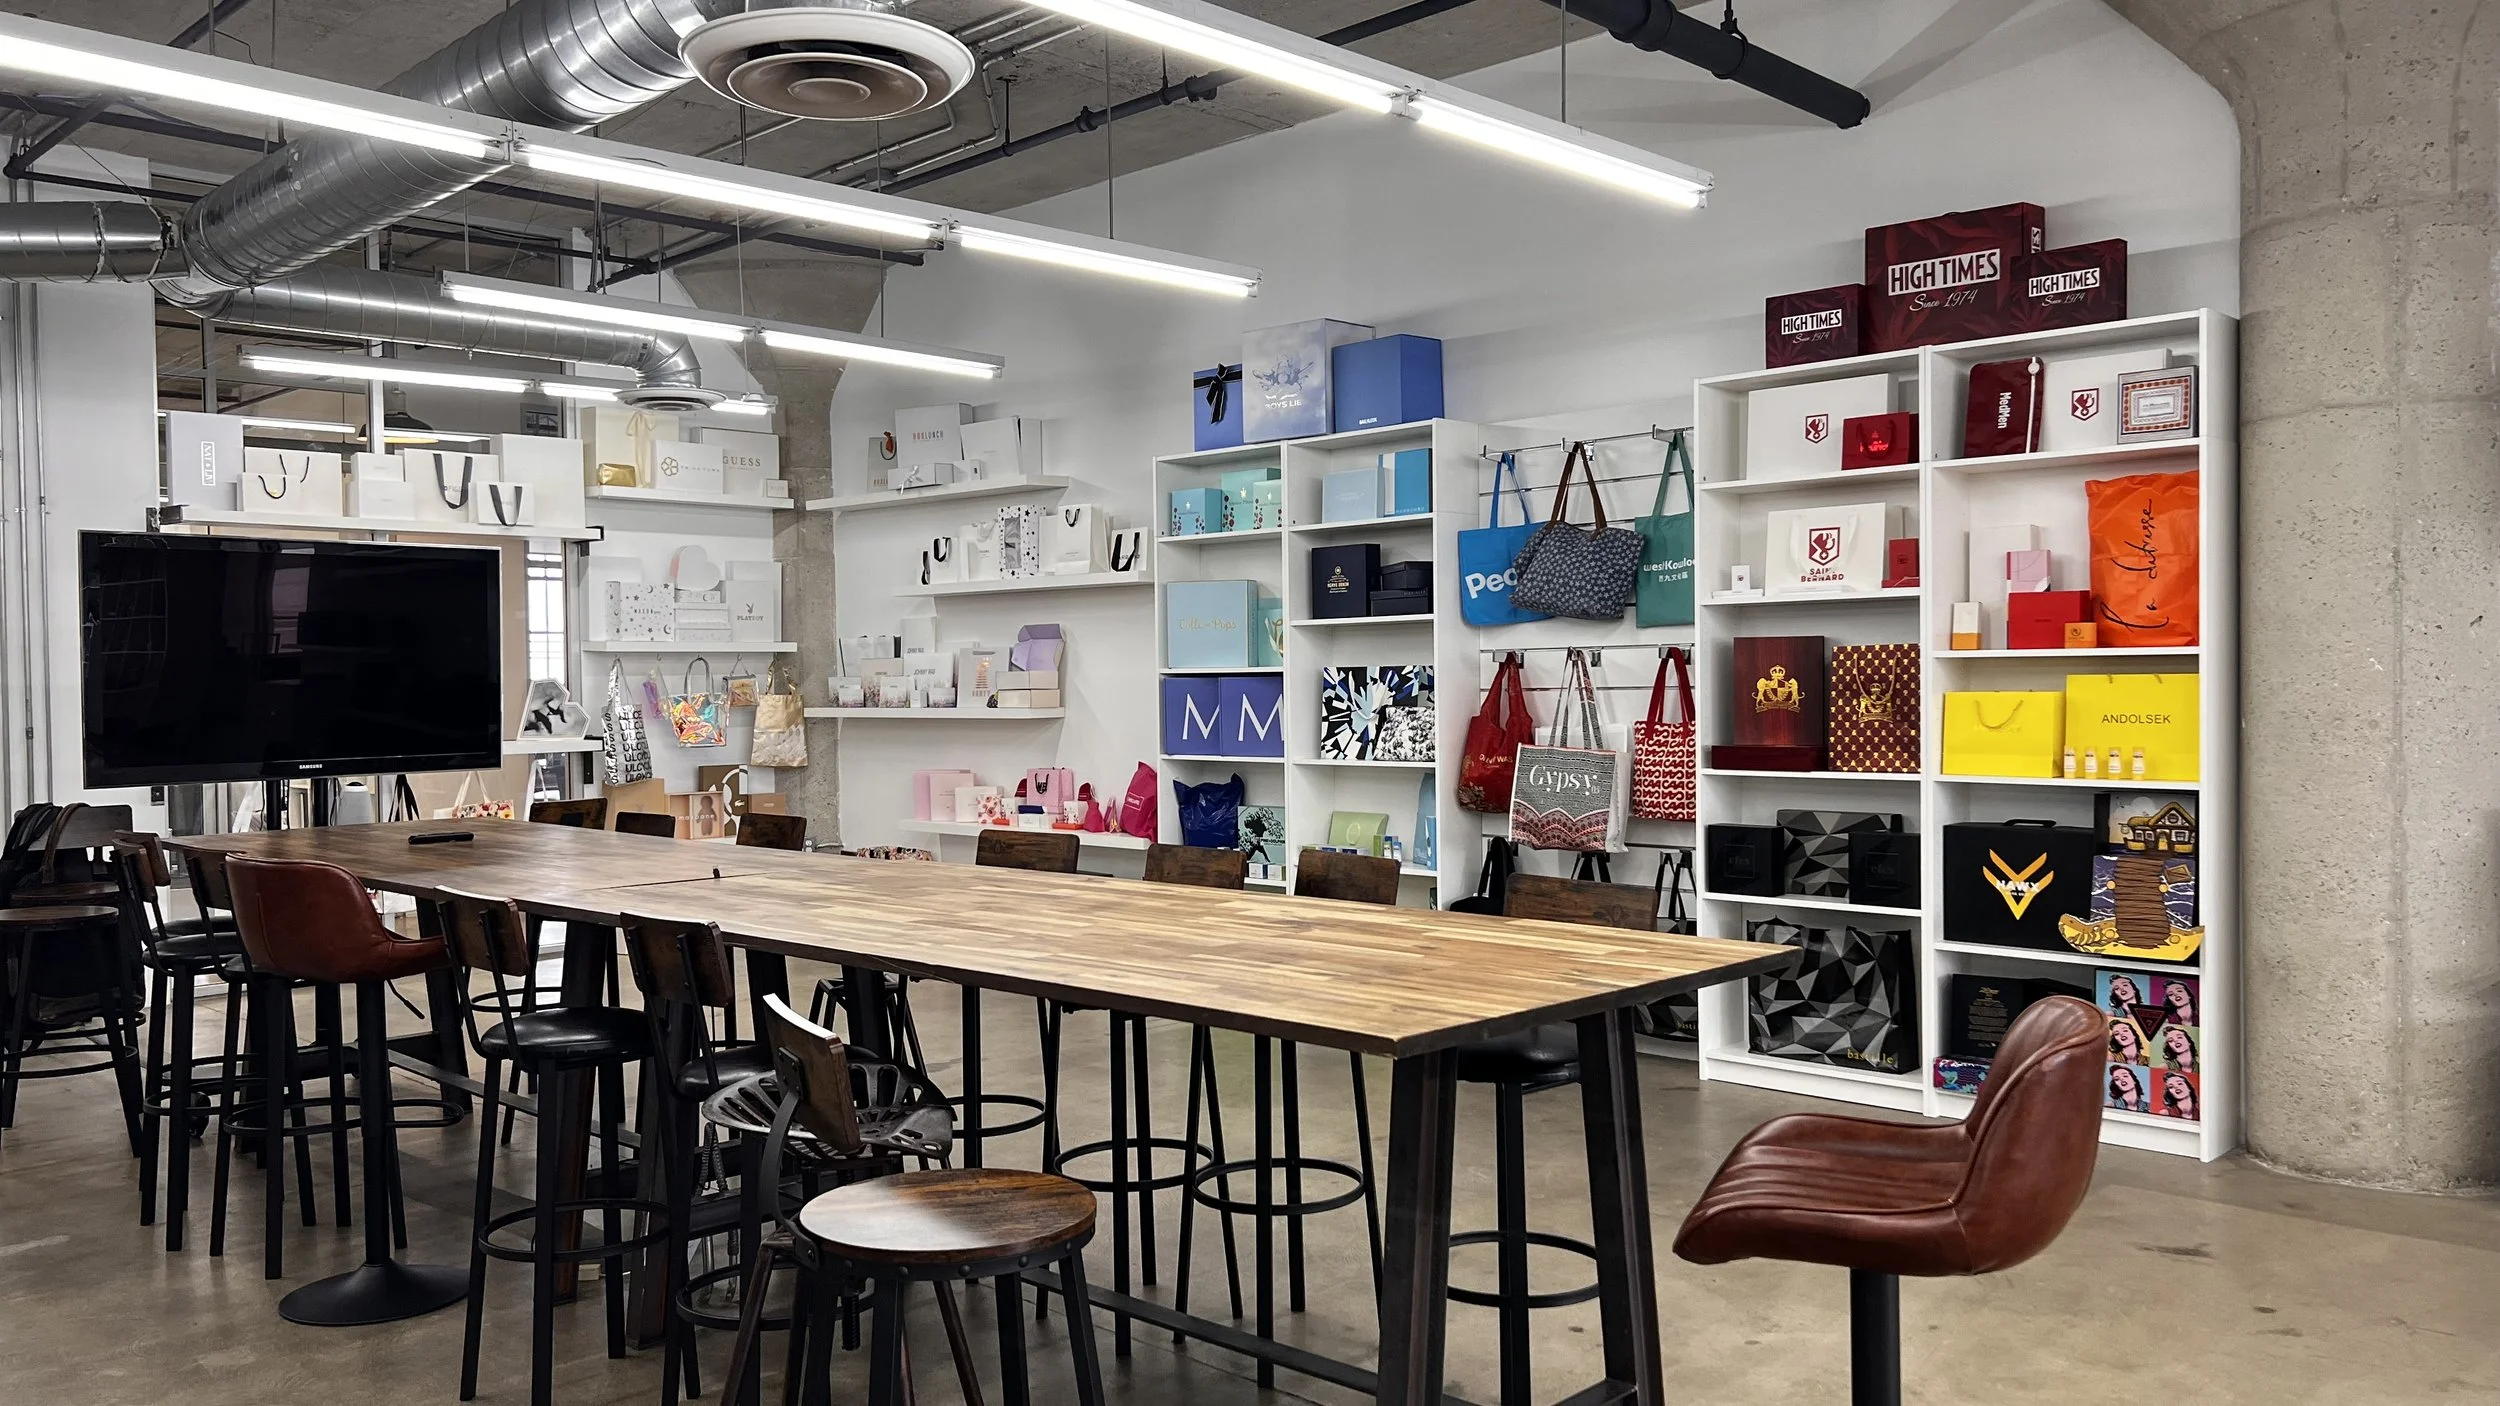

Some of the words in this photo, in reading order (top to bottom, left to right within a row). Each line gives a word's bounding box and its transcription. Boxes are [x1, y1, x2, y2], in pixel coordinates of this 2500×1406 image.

[1891, 261, 1936, 293] HIGH
[1939, 252, 1999, 285] TIMES
[2031, 276, 2062, 295] HIGH
[2062, 270, 2098, 290] TIMES
[1909, 293, 1940, 312] Since
[1942, 289, 1978, 308] 1974
[2064, 292, 2085, 304] 1974
[1783, 316, 1808, 333] HIGH
[1809, 311, 1840, 329] TIMES
[1265, 400, 1288, 409] BOYS
[1997, 392, 2012, 429] MedMen
[722, 456, 761, 467] GUESS
[1801, 573, 1844, 582] BERNARD
[1238, 693, 1285, 741] M
[2101, 714, 2172, 724] ANDOLSEK
[1643, 758, 1662, 768] CAA
[1664, 758, 1684, 768] CAA
[1529, 764, 1598, 796] Gypsy
[1642, 779, 1661, 790] CAA
[1662, 779, 1684, 790] CAA
[1644, 800, 1661, 810] CAA
[1662, 800, 1684, 810] CAA
